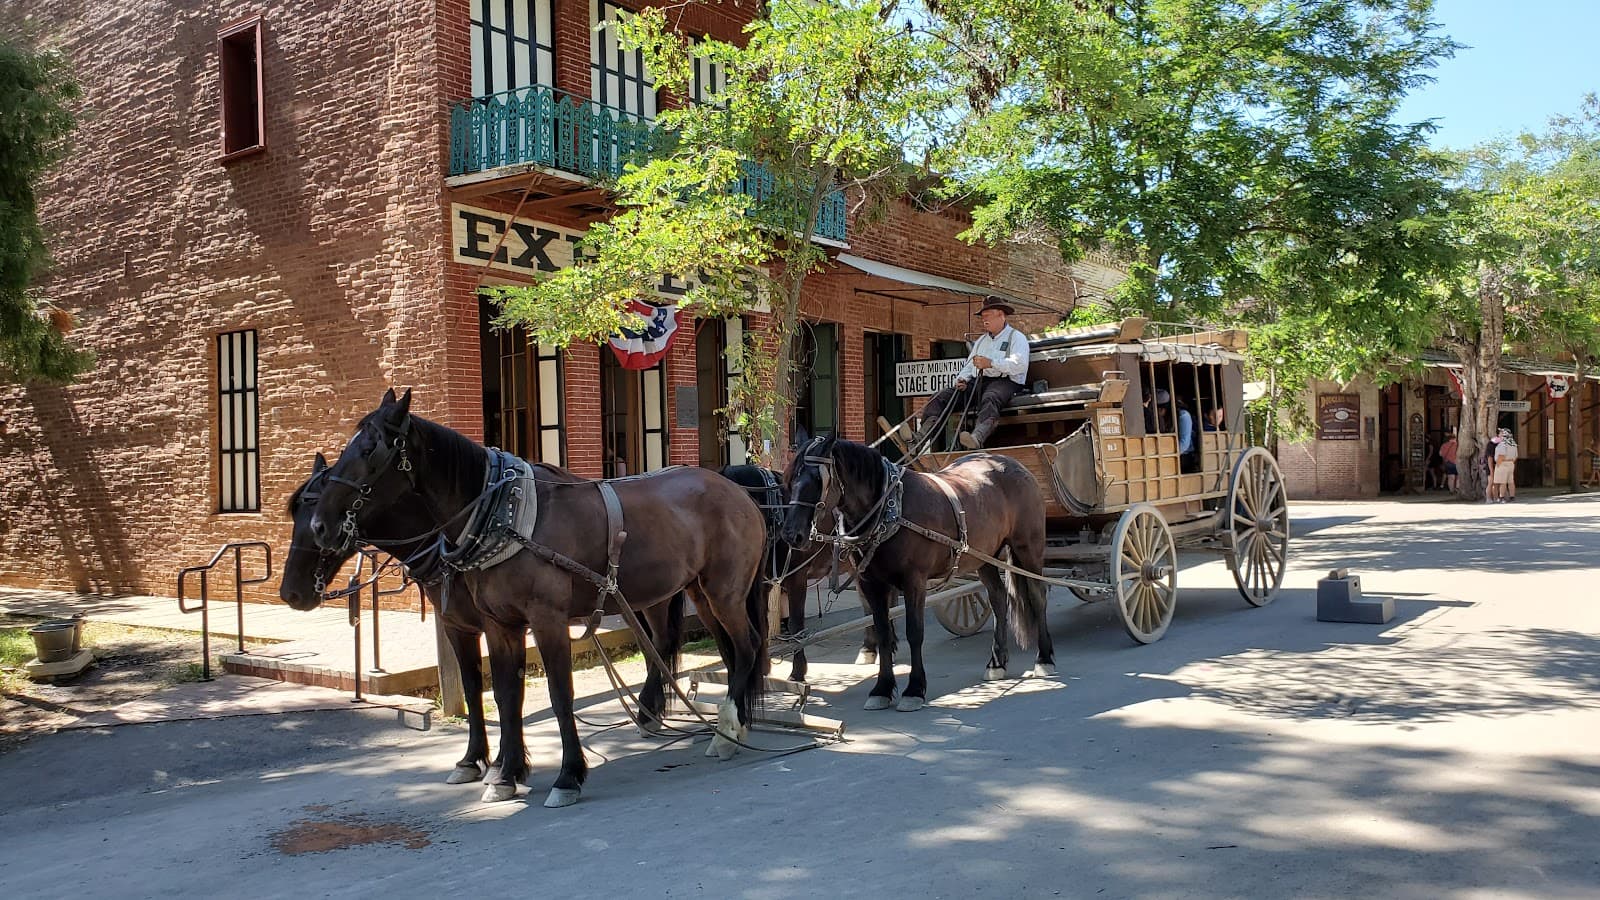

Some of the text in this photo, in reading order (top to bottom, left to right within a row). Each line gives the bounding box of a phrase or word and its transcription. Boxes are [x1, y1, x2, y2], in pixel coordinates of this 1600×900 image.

[898, 361, 965, 375] QUARTZ MOUNTAIN
[898, 373, 958, 393] STAGE OFFIC
